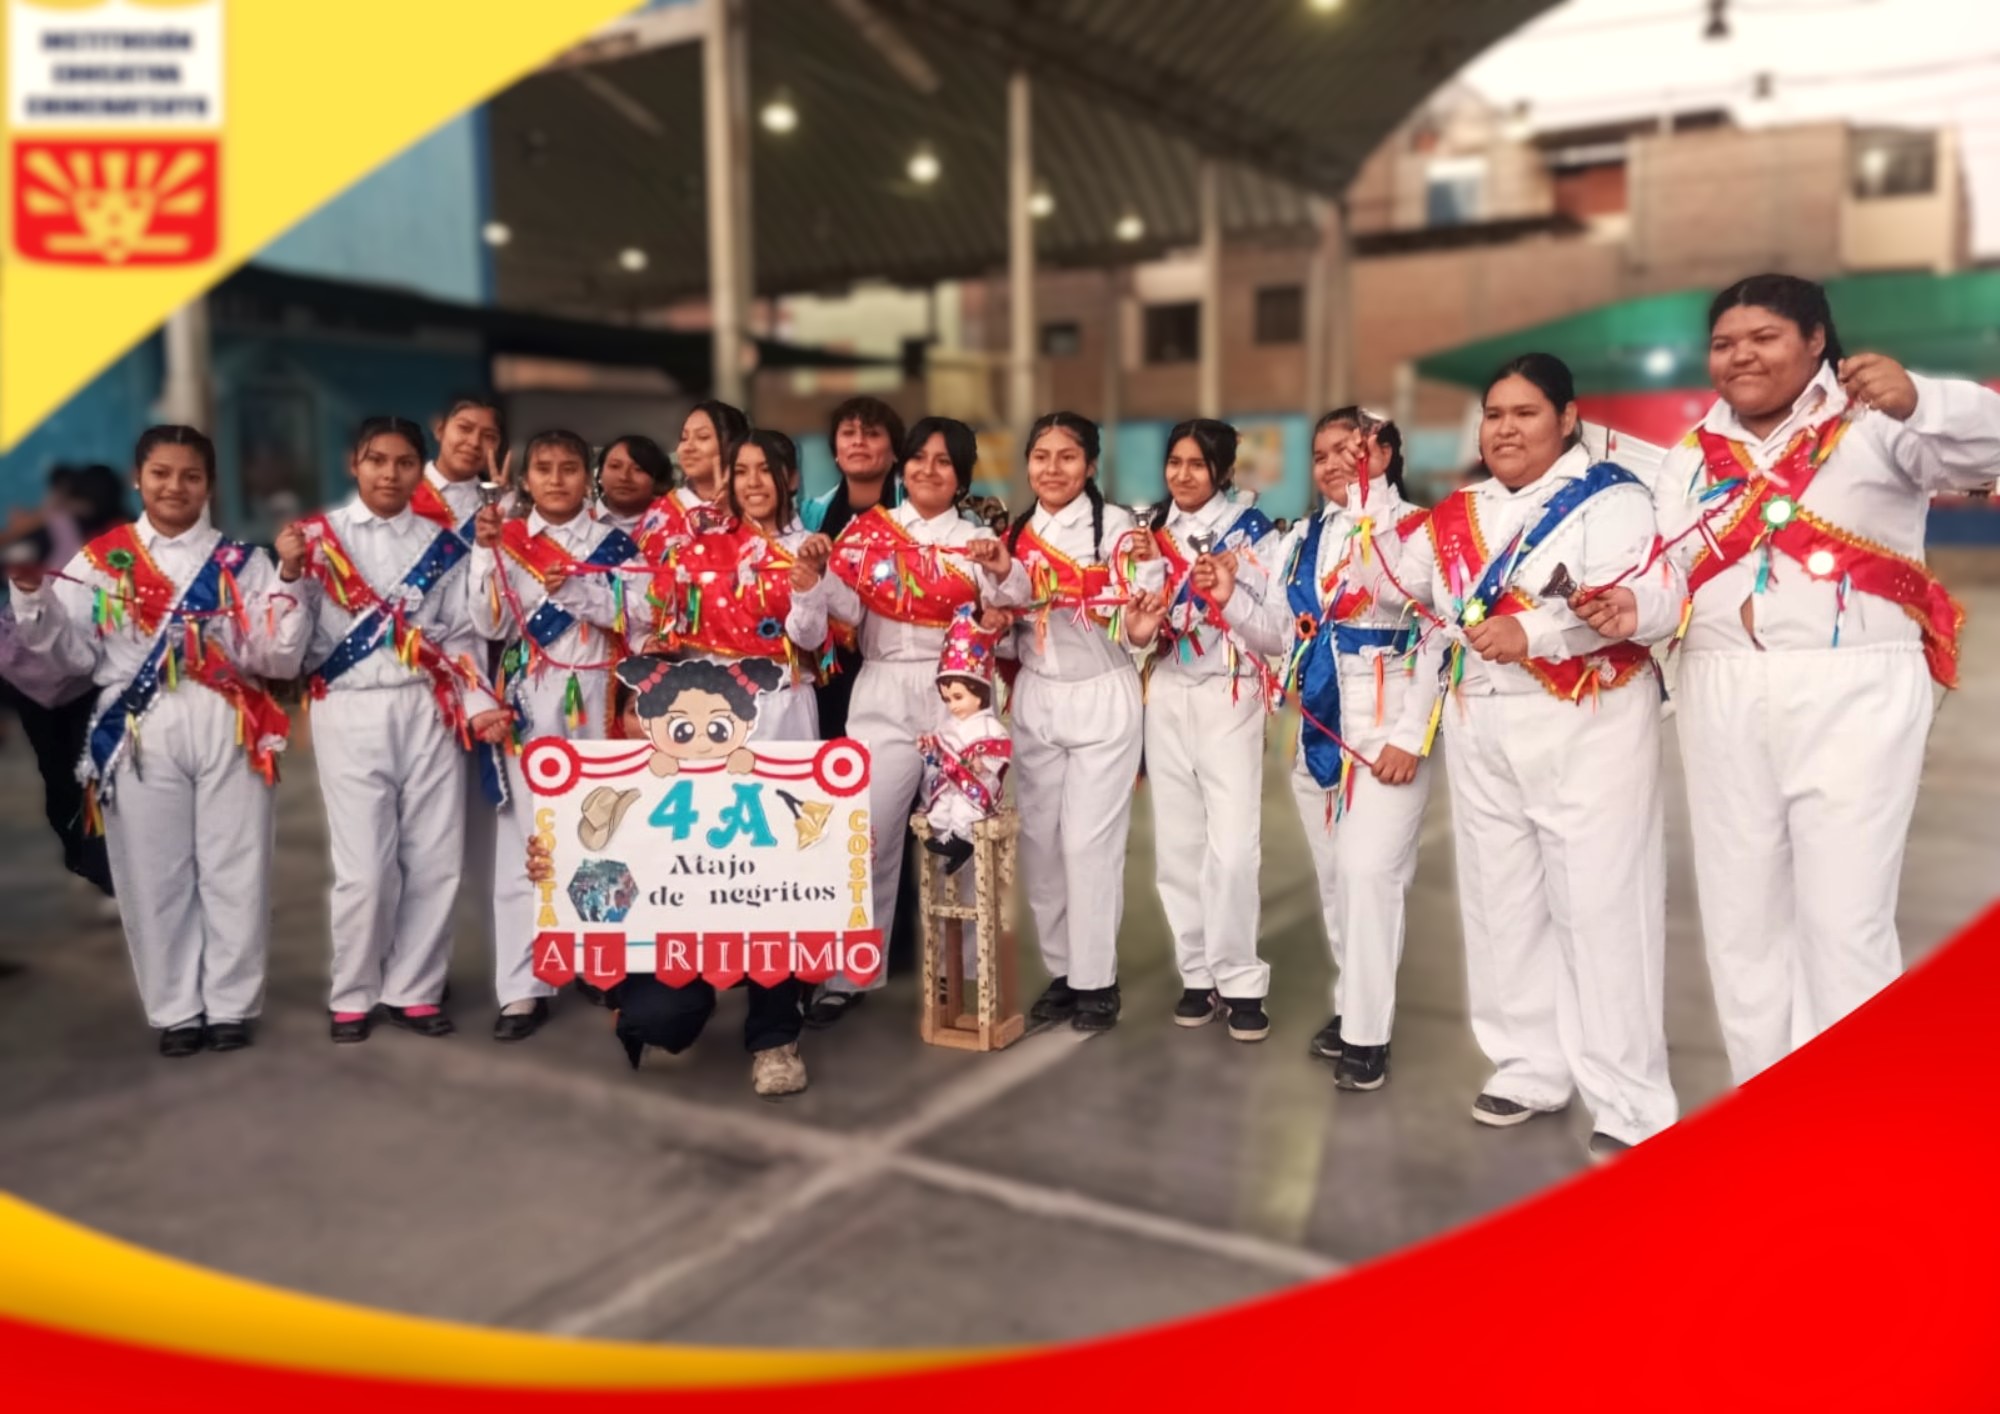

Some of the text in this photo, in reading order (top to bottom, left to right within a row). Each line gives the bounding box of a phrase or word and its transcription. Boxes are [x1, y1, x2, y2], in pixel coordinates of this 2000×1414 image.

[648, 780, 778, 849] 4 A
[669, 855, 755, 879] Atajo
[847, 811, 869, 928] COSTA
[649, 882, 836, 907] de negritos
[538, 940, 881, 976] AL RITMO
